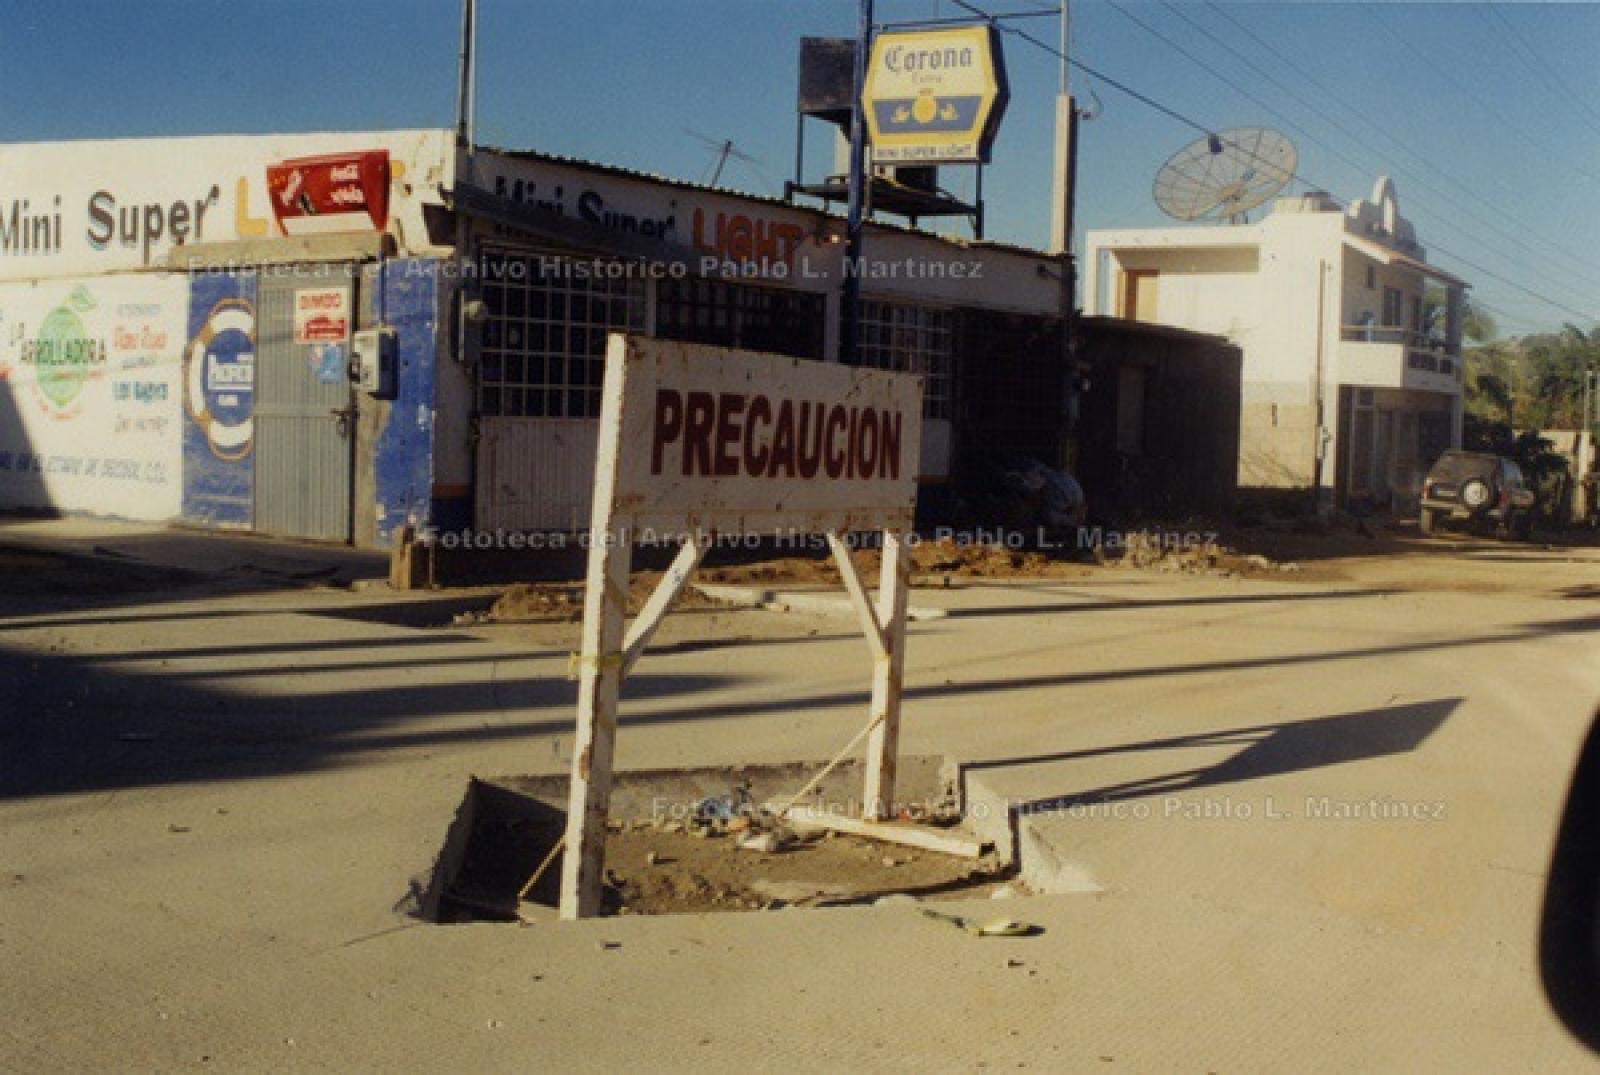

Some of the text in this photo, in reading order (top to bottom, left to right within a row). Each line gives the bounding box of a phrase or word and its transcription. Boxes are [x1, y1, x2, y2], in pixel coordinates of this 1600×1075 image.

[884, 44, 973, 73] Corona
[692, 206, 803, 266] LIGHT
[651, 388, 902, 481] PRECAUCION
